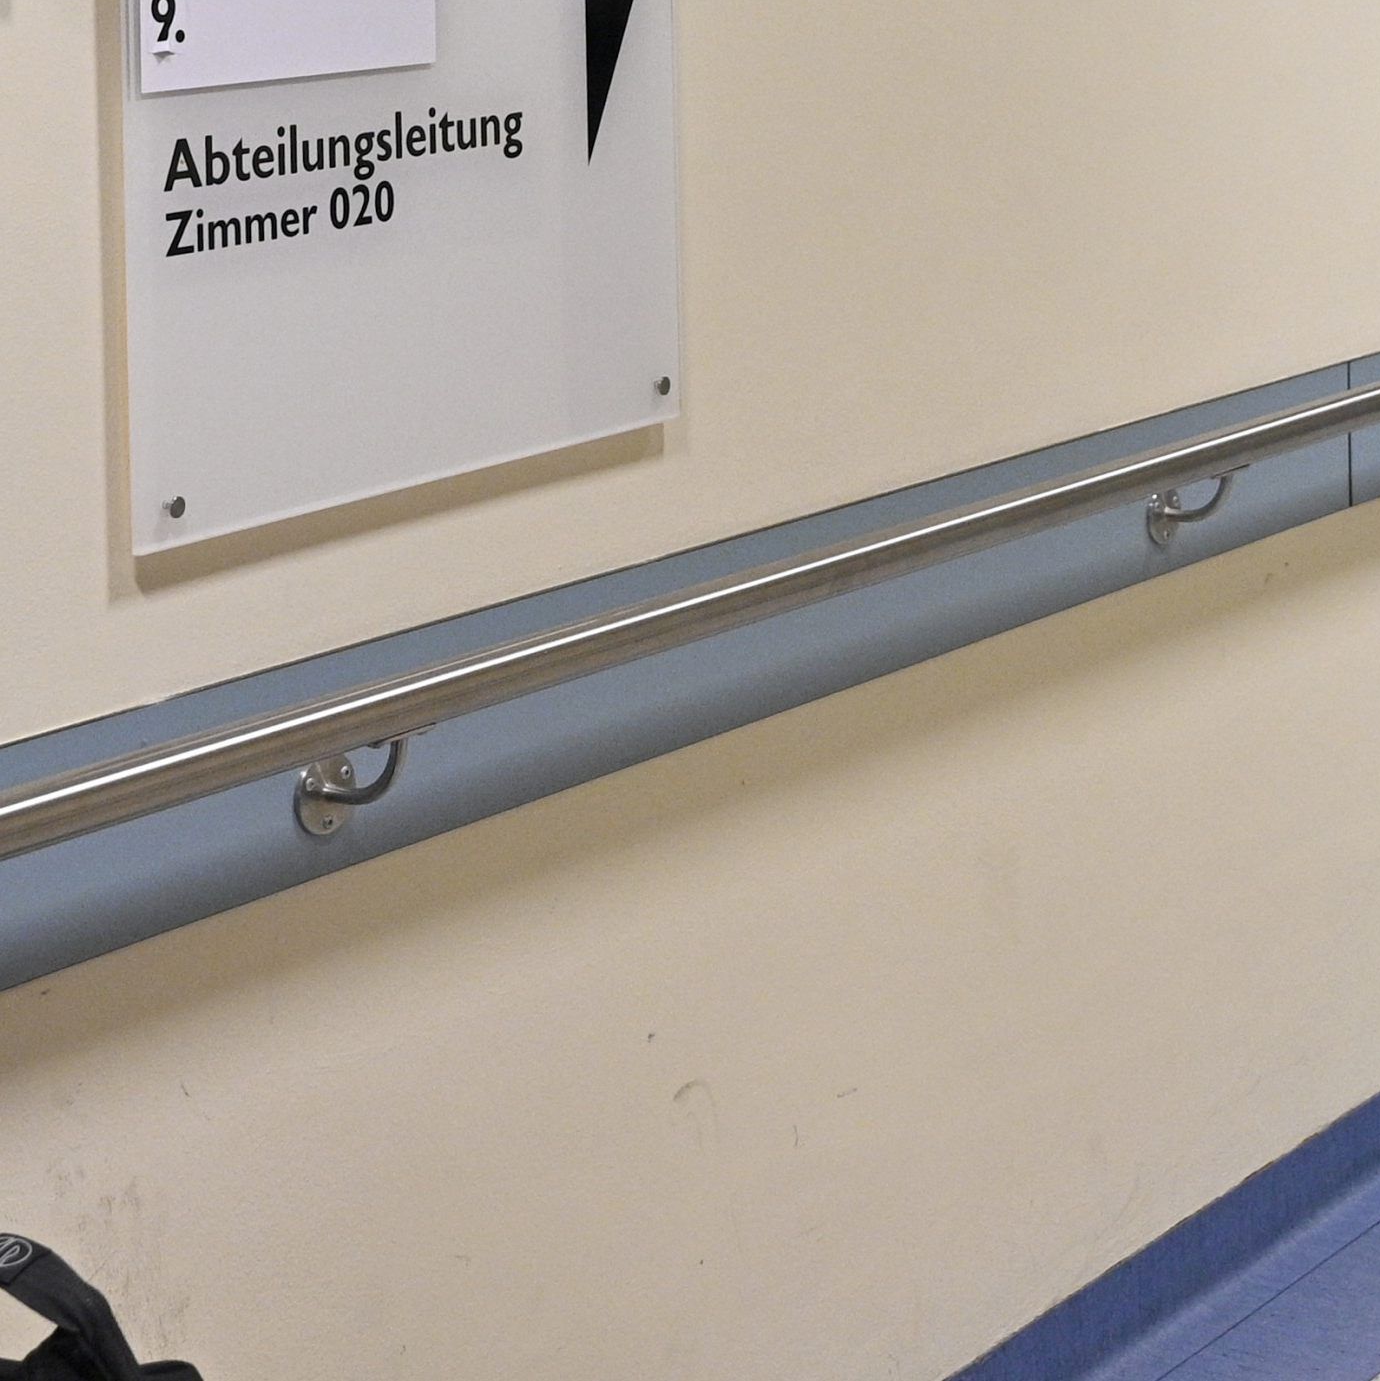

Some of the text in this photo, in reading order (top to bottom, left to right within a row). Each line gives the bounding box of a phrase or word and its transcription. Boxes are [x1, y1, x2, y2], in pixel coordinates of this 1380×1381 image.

[163, 107, 523, 192] Abteilungsleitung
[165, 180, 395, 258] Zimmer 020
